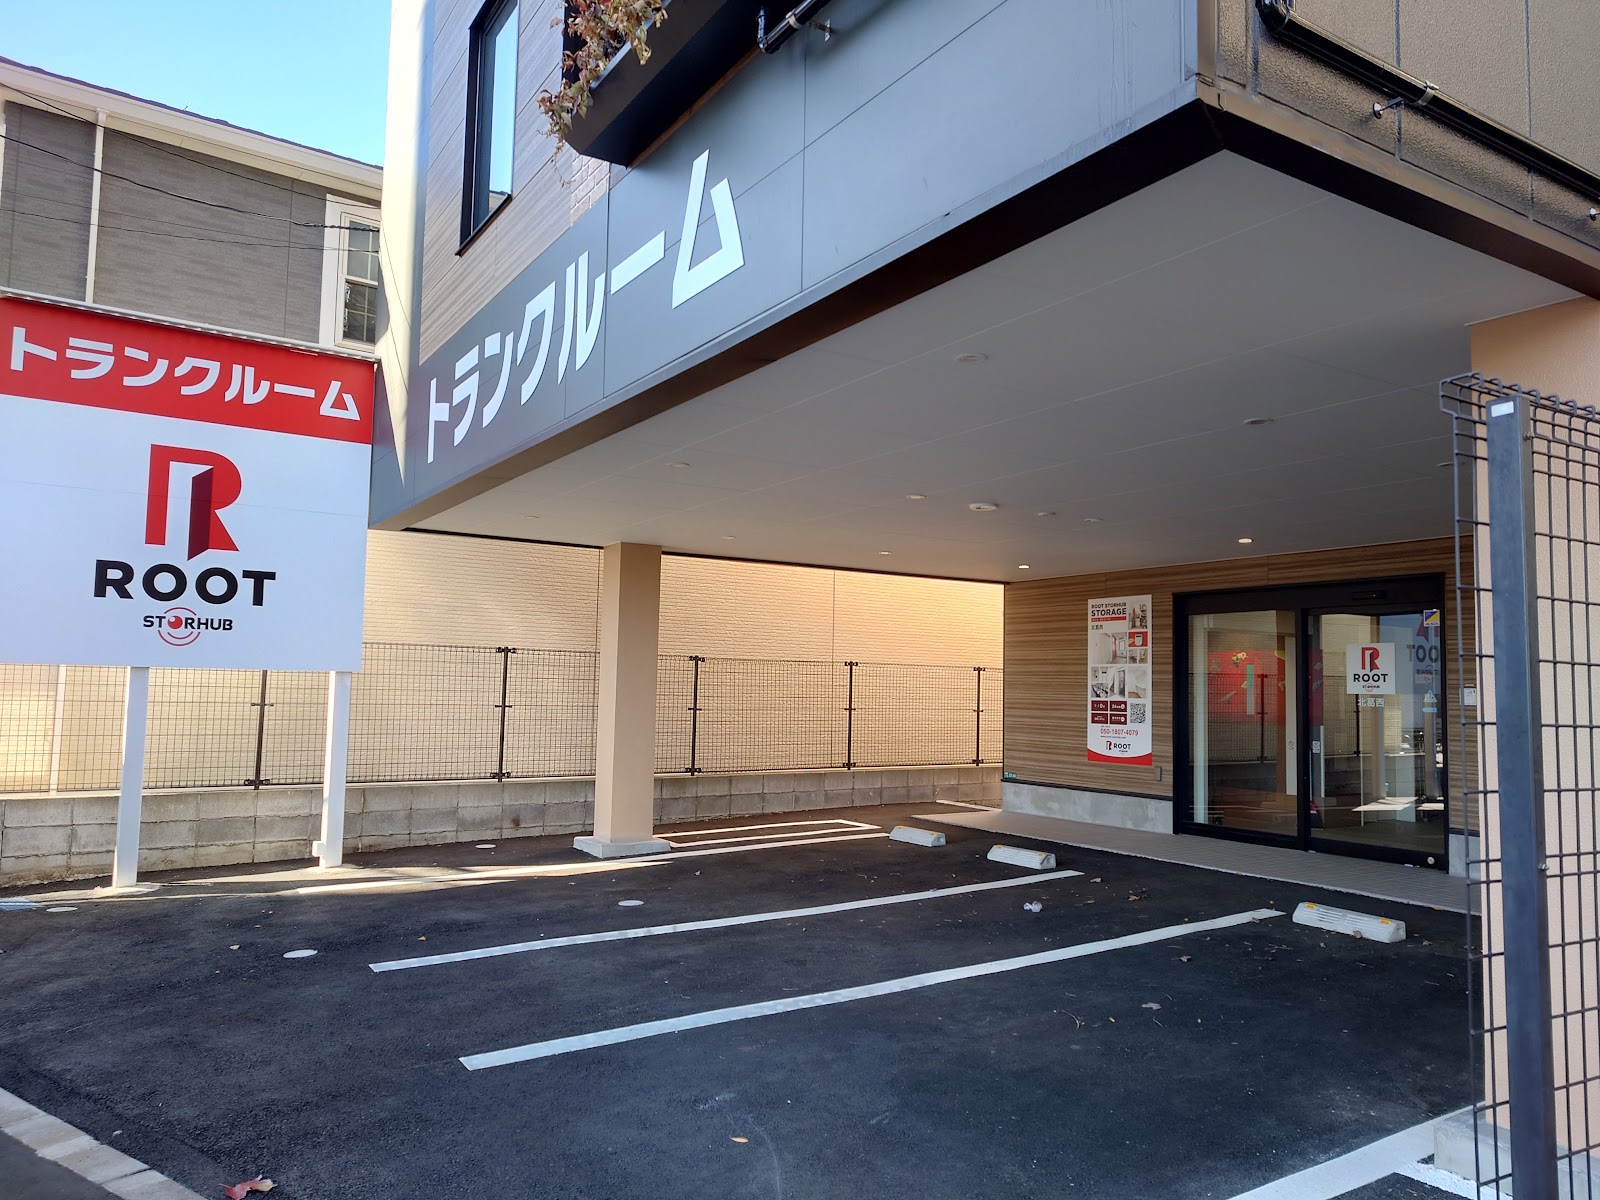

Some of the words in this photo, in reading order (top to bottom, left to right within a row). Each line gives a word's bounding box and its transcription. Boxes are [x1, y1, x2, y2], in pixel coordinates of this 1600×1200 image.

[427, 149, 745, 464] トランクルーム
[10, 326, 361, 421] トランクルーム
[94, 559, 276, 606] ROOT
[143, 614, 233, 631] STORHUB
[1091, 607, 1126, 617] STORAGE
[1353, 674, 1388, 682] ROOT
